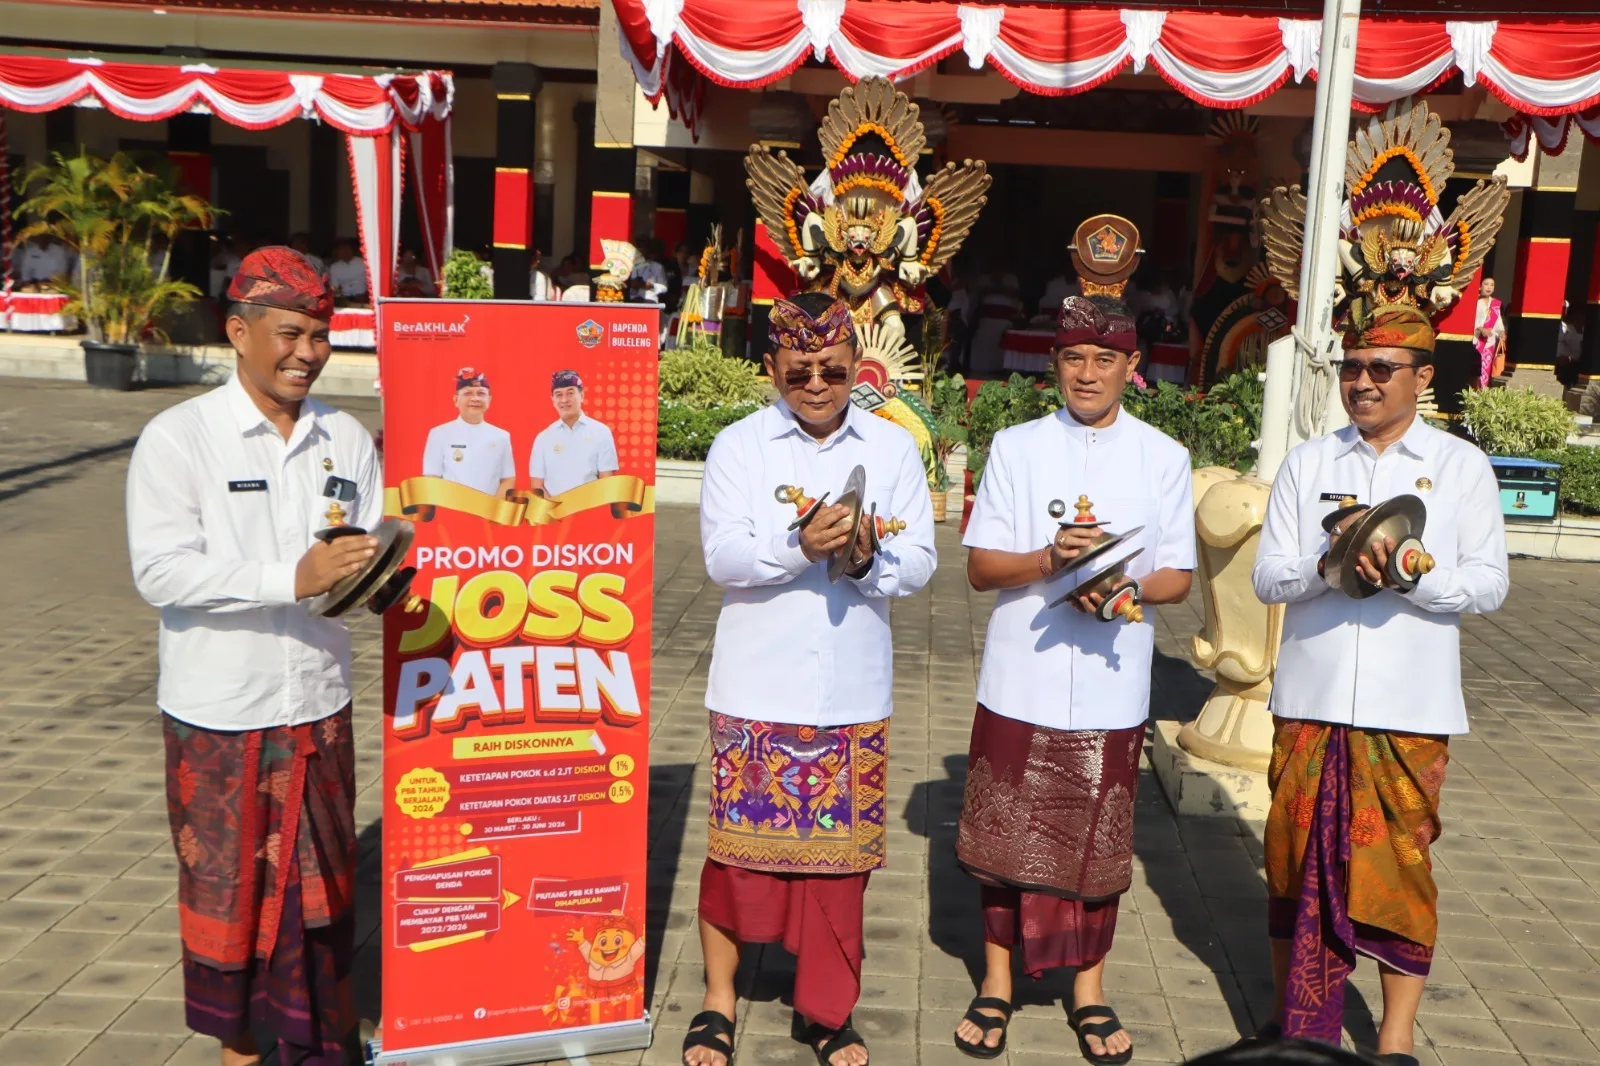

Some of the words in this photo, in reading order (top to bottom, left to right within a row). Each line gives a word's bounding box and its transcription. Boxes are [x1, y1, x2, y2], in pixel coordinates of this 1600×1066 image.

[393, 321, 465, 333] BerAKHLAK
[612, 323, 648, 333] BAPENDA
[612, 337, 651, 347] BULELENG
[416, 546, 524, 570] PROMO
[532, 542, 634, 567] DISKON
[398, 570, 635, 653] JOSS
[392, 646, 642, 732] PATEN
[473, 742, 502, 752] RAIH
[505, 737, 574, 750] DISKONNYA
[459, 771, 509, 783] KETETAPAN
[510, 769, 542, 779] POKOK
[543, 769, 556, 777] s.d
[557, 767, 573, 776] 2JT
[574, 764, 606, 775] DISKON
[616, 760, 629, 772] 1%
[403, 796, 444, 804] BERJALAN
[459, 800, 503, 811] KETETAPAN
[504, 797, 533, 807] POKOK
[533, 795, 562, 805] DIATAS
[562, 793, 577, 803] 2JT
[577, 791, 606, 802] DISKON
[611, 786, 632, 797] 0,5%
[412, 804, 434, 812] 2026
[507, 816, 537, 824] BERLAKU
[493, 825, 517, 833] MARET
[548, 821, 566, 829] 2026
[404, 873, 463, 882] PENGHAPUSAN
[464, 869, 493, 878] POKOK
[435, 881, 463, 889] DENDA
[536, 891, 568, 900] PIUTANG
[569, 889, 583, 897] PBB
[584, 887, 594, 895] KE
[595, 886, 621, 894] BAWAH
[555, 897, 603, 907] DIHAPUSKAN
[413, 907, 440, 916] CUKUP
[441, 904, 475, 913] DENGAN
[400, 916, 444, 926] MEMBAYAR
[461, 912, 487, 921] TAHUN
